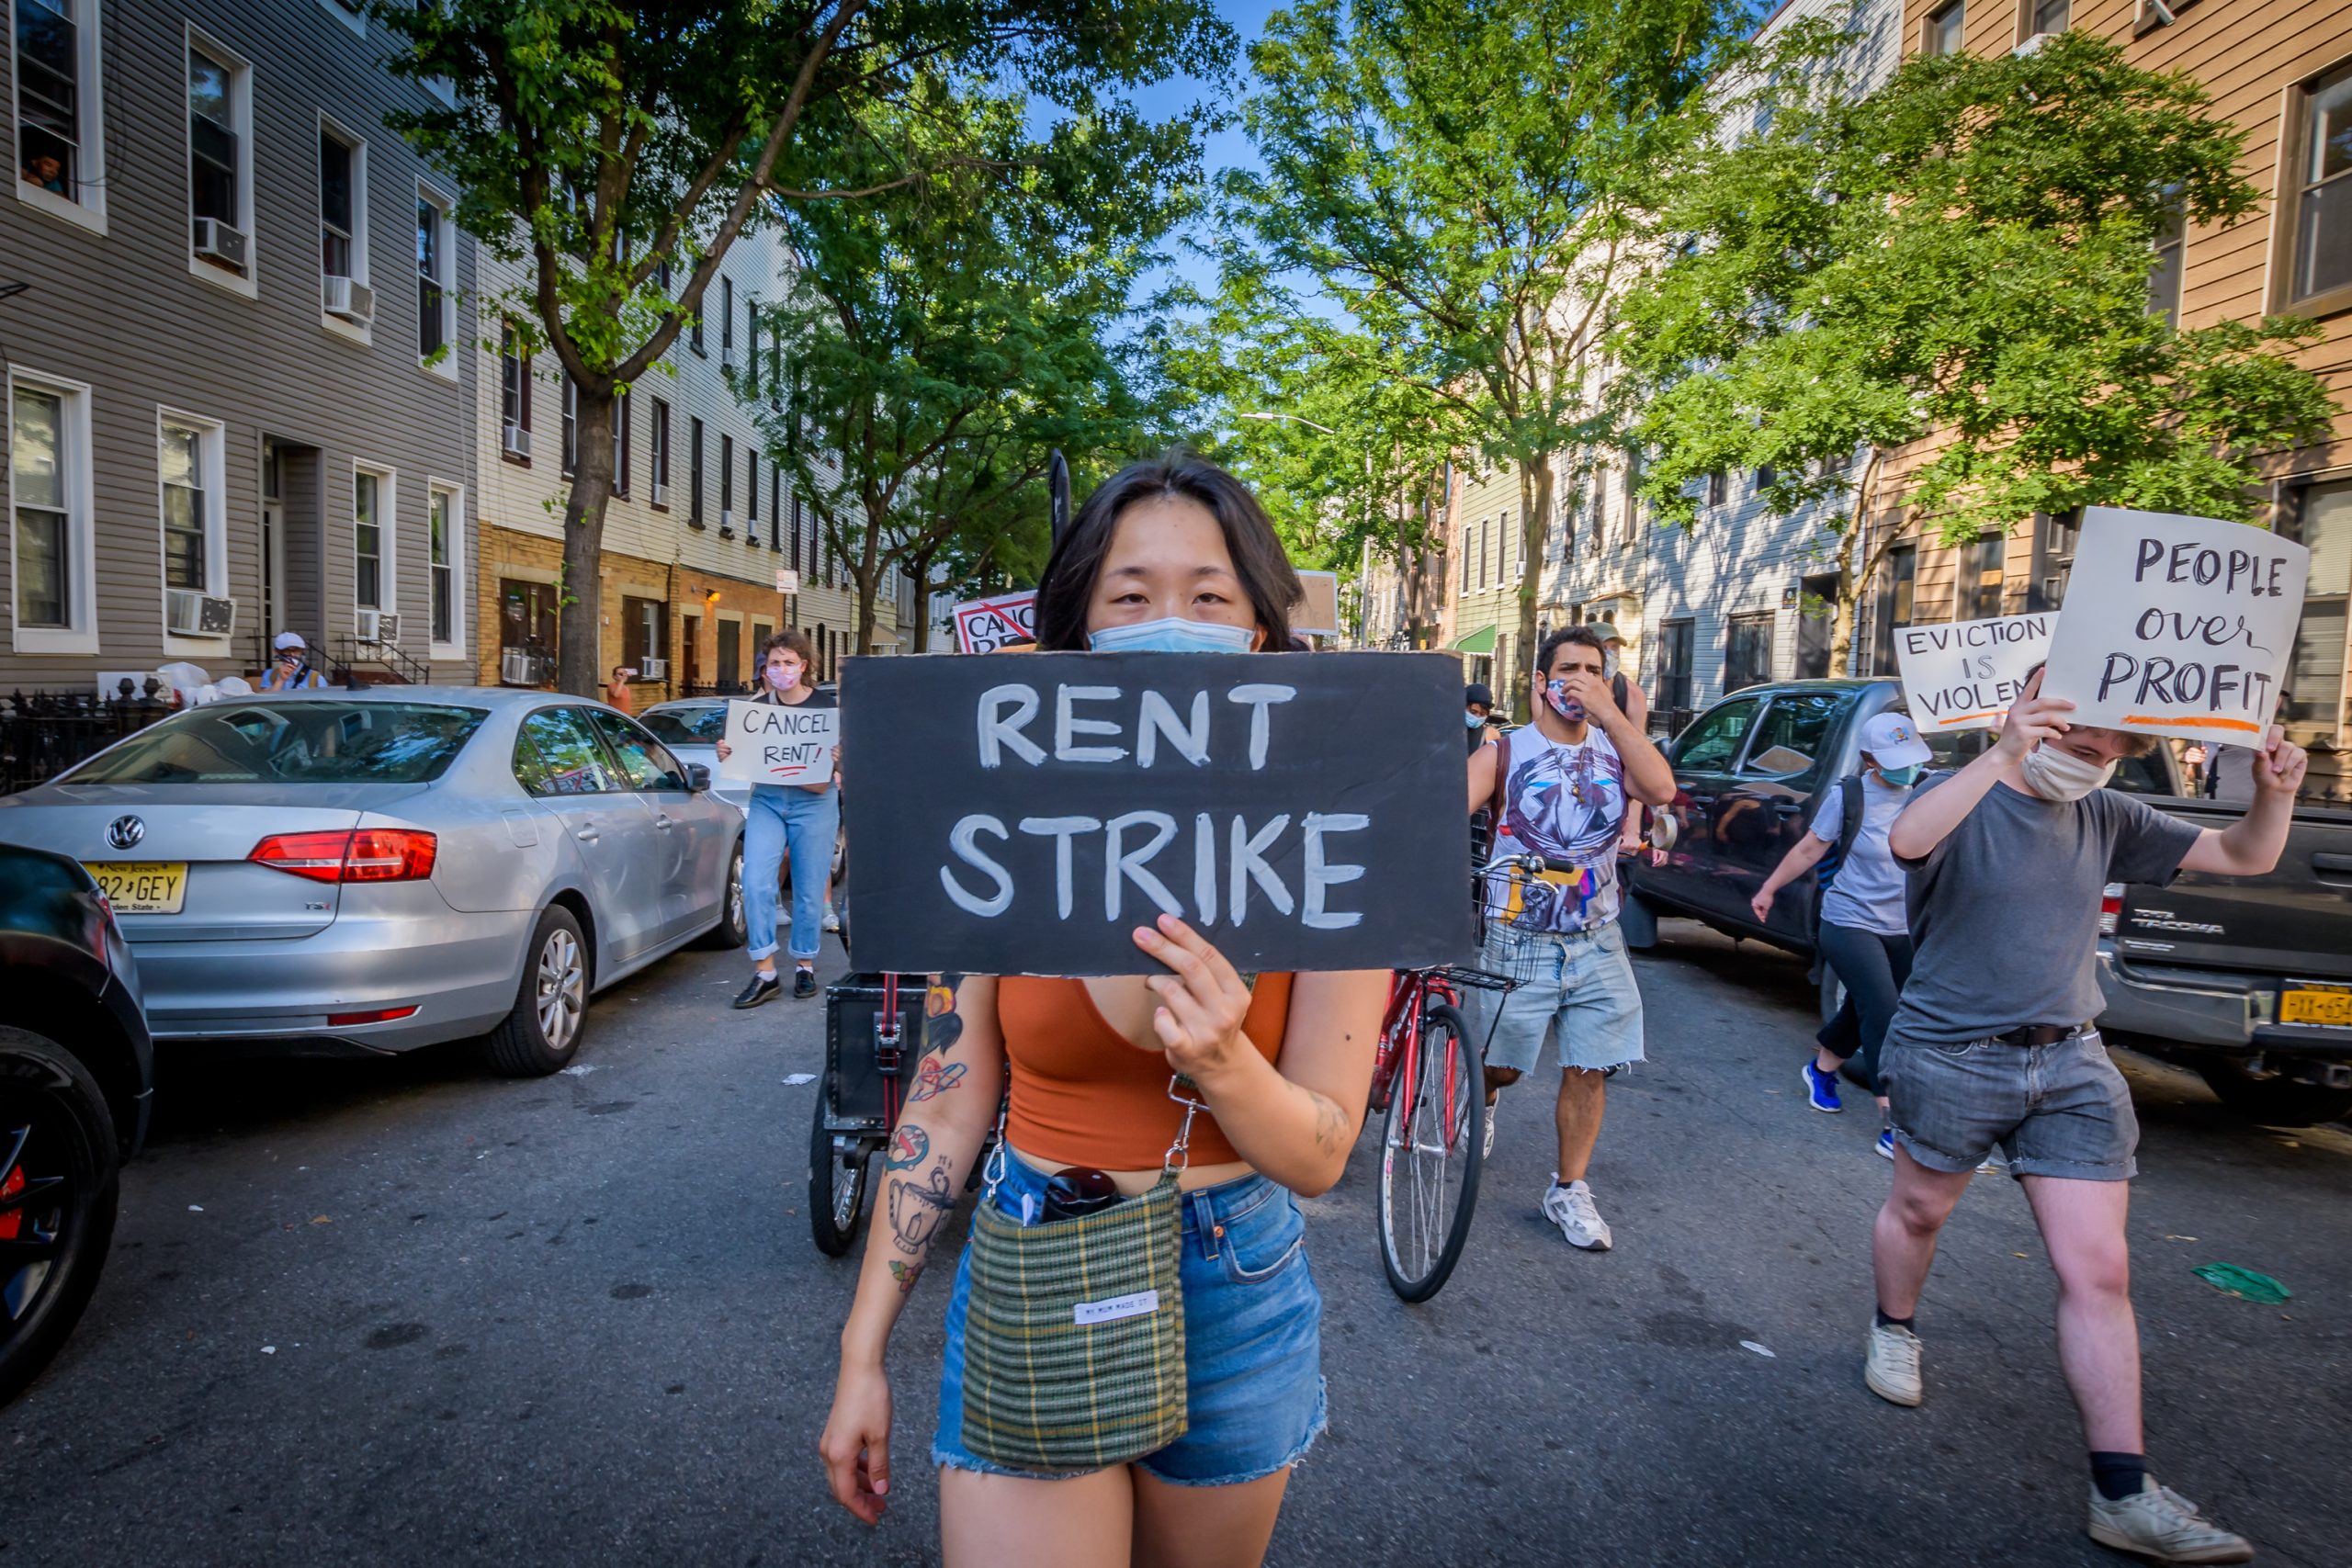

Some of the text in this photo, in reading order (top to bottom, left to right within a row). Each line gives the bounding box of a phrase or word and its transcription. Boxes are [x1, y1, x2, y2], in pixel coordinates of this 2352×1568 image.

[2135, 538, 2287, 597] PEOPLE
[1906, 617, 2047, 655] EVICTION
[2135, 607, 2274, 658] over
[1962, 654, 1996, 680] IS
[2098, 652, 2271, 720] PROFIT
[743, 709, 831, 735] CANCEL
[977, 682, 1297, 770] RENT
[764, 742, 822, 764] RENT!
[940, 810, 1370, 930] STRIKE
[2131, 919, 2225, 935] TACOMA
